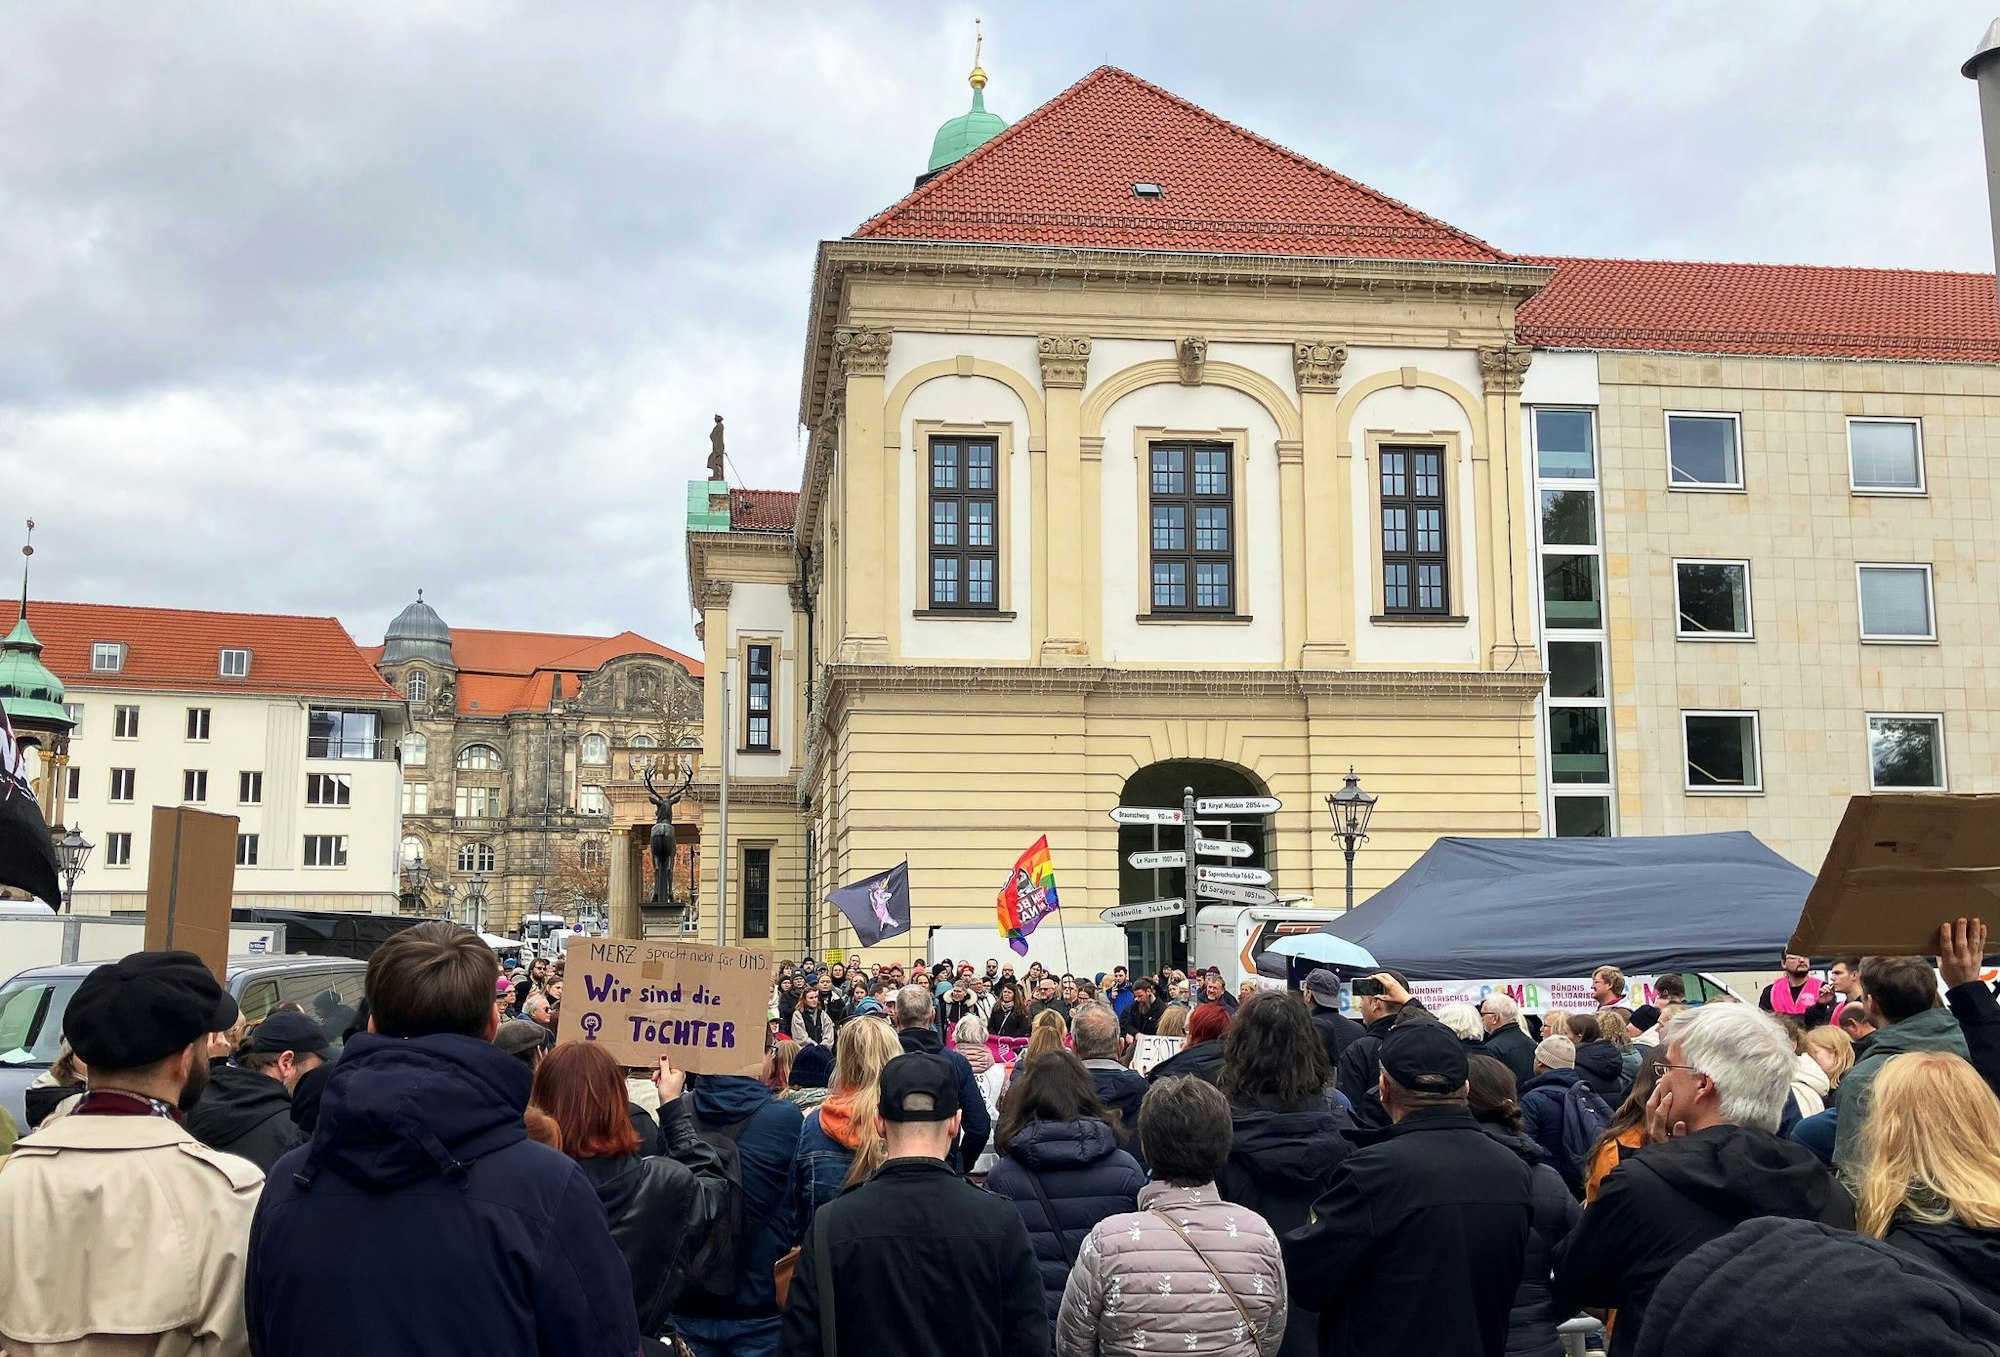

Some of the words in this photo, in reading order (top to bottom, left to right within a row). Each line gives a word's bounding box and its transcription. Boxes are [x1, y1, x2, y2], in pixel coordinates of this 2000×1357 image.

[1208, 802, 1223, 810] Kiryat
[1245, 801, 1261, 809] 2854
[1119, 811, 1149, 820] Braunschweig
[1204, 843, 1220, 851] Radom
[1241, 872, 1254, 880] 1662
[1208, 885, 1235, 896] Sarajevo
[1245, 890, 1258, 899] 1051
[1110, 908, 1142, 918] Nashville
[1148, 905, 1163, 913] 7441
[590, 943, 637, 964] MERZ
[645, 948, 687, 964] spricht
[690, 949, 714, 963] nicht
[717, 953, 735, 971] für
[739, 953, 768, 970] UNS.
[583, 972, 632, 1003] Wir
[639, 981, 682, 1004] sind
[692, 984, 721, 1006] die
[1409, 985, 1443, 995] BÜNDNIS
[1551, 983, 1585, 992] BÜNDNIS
[1414, 994, 1470, 1003] OLIDARISCHES
[1552, 1000, 1597, 1008] MAGDEBURG
